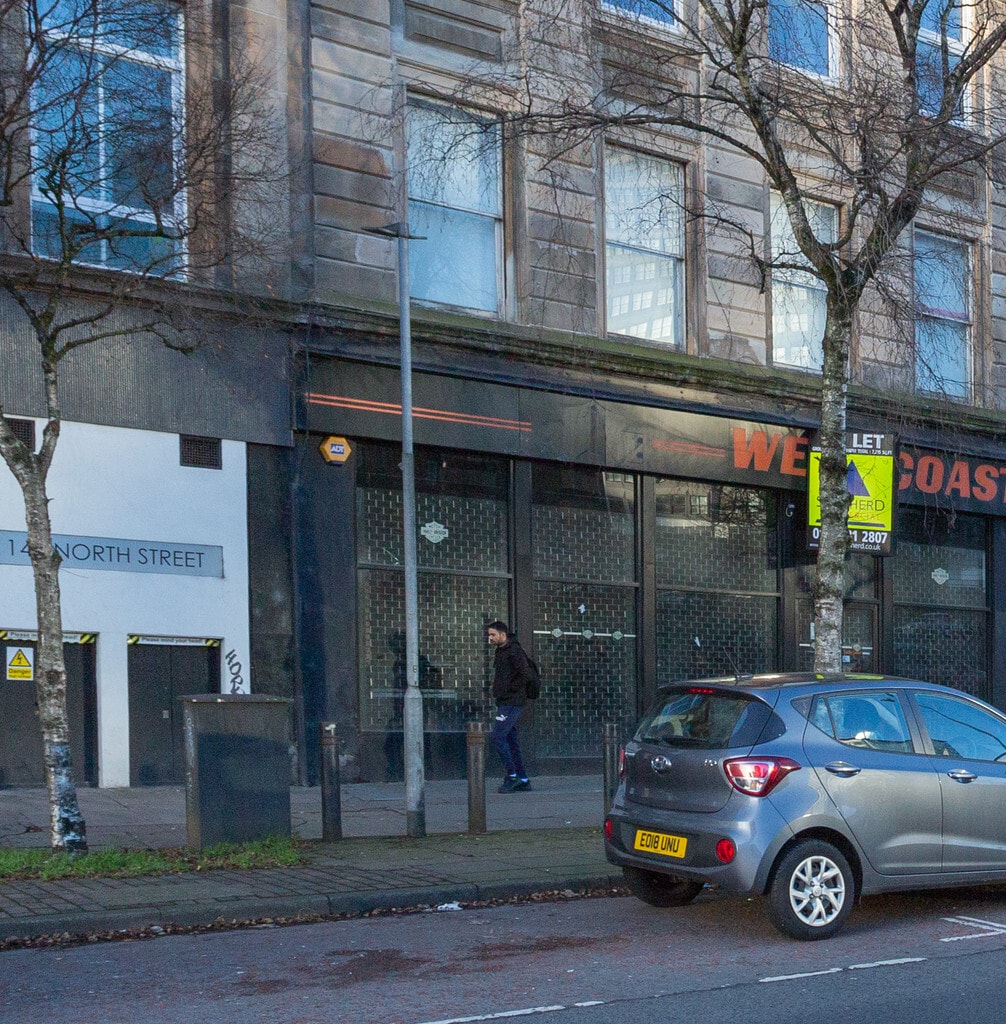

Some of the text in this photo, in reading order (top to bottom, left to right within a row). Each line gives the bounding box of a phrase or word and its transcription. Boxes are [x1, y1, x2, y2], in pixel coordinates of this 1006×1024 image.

[852, 433, 884, 449] LET
[732, 427, 810, 476] WE
[862, 530, 888, 544] 2807
[55, 543, 130, 564] NORTH
[138, 547, 205, 568] STREET
[661, 837, 680, 853] UNU
